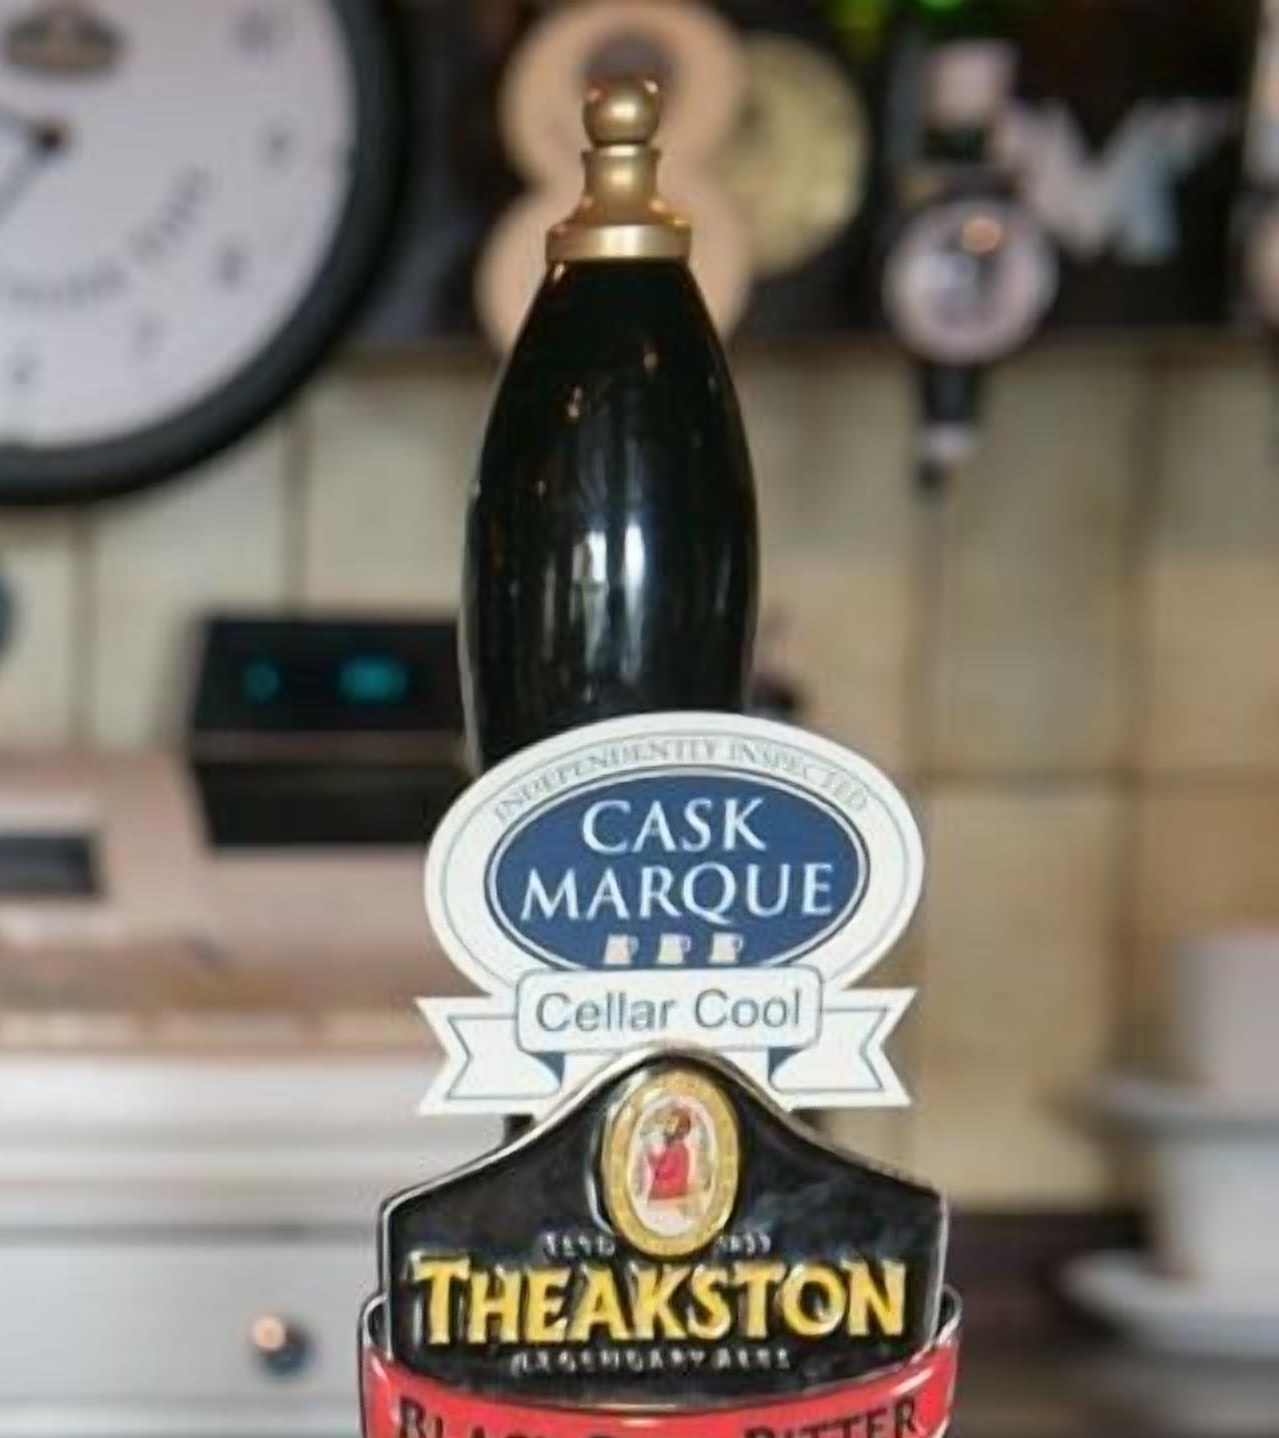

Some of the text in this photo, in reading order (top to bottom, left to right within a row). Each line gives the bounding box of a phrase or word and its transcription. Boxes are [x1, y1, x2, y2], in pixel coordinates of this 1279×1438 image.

[492, 736, 717, 825] INDEPENDENTLY
[581, 797, 768, 855] CASK
[519, 861, 834, 926] MARQUE
[534, 986, 802, 1034] Cellar Cool
[409, 1251, 907, 1345] THEAKSTON
